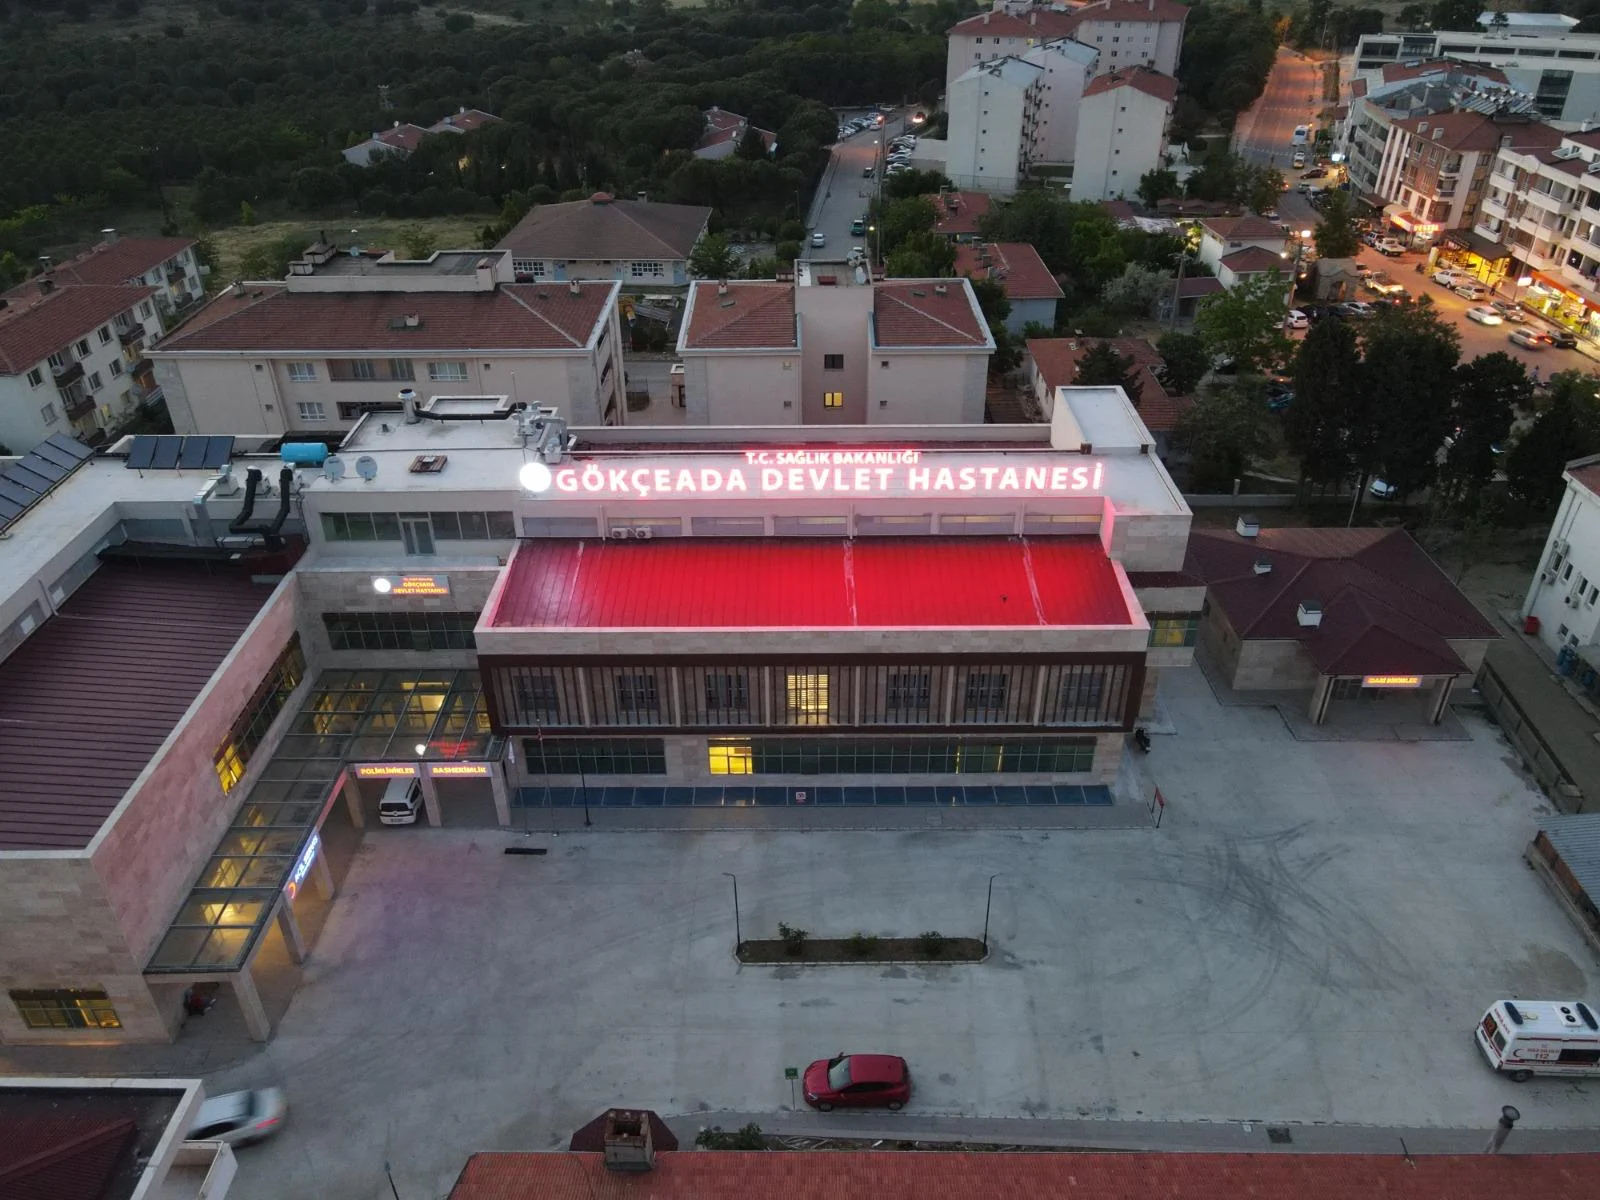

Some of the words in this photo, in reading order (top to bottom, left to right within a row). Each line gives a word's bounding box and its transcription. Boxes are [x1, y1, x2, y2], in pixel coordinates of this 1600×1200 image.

[746, 451, 774, 465] T.C.
[776, 449, 831, 465] SAĞLIK
[832, 449, 921, 465] BAKANLIĞI
[556, 463, 748, 497] GÖKÇEADA
[761, 466, 894, 492] DEVLET
[907, 461, 1105, 491] HASTANESİ
